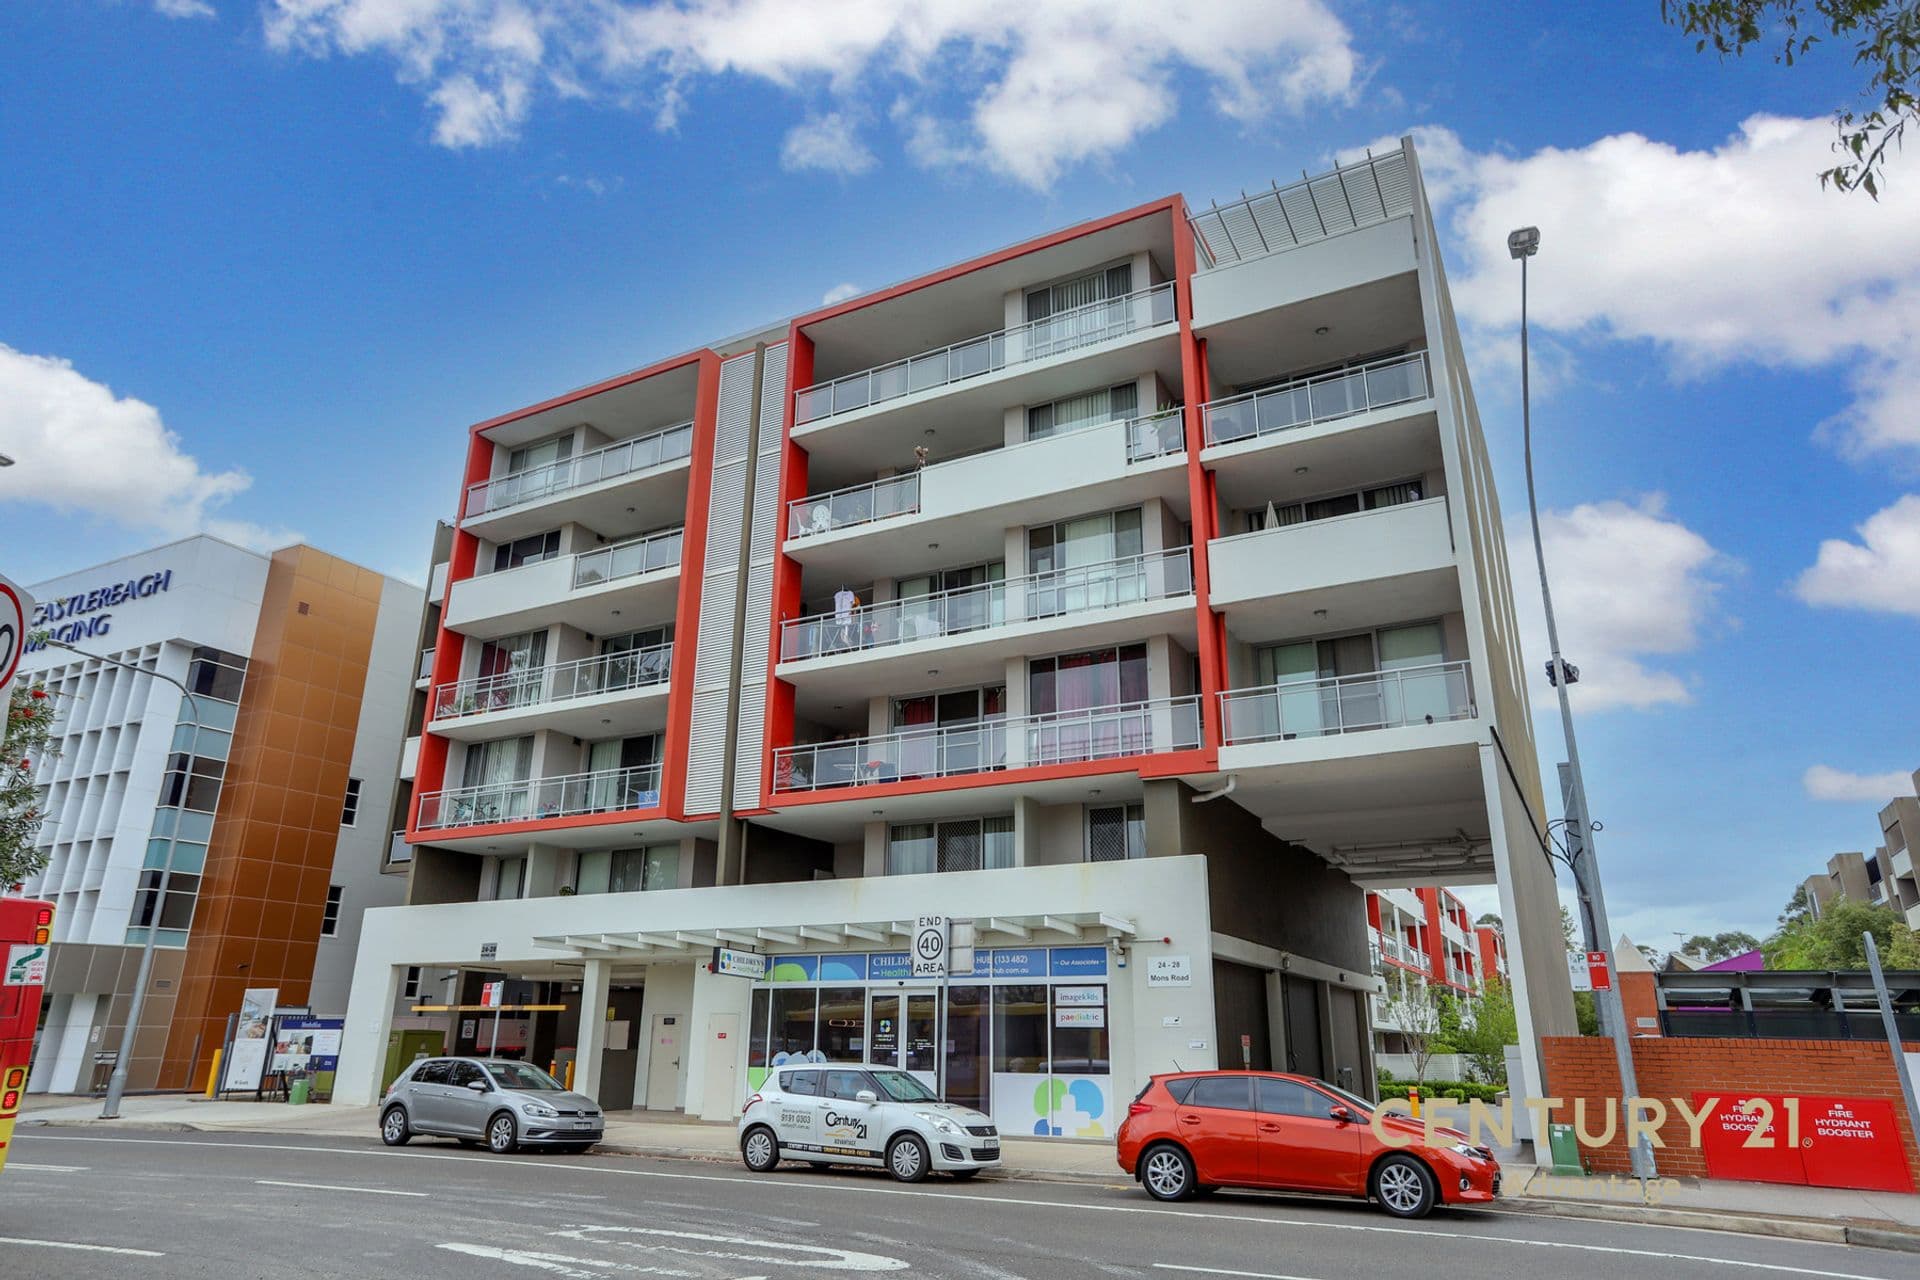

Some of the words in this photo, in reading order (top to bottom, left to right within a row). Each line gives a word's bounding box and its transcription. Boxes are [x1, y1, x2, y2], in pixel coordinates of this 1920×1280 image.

[31, 569, 172, 627] CASTLEREAGH
[919, 916, 942, 927] END
[920, 937, 940, 952] 40
[872, 956, 912, 967] CHILDR
[915, 962, 945, 973] AREA
[1828, 1109, 1854, 1118] FIRE
[825, 1111, 861, 1129] Century
[856, 1124, 867, 1139] 21
[1722, 1122, 1775, 1133] BOOSR
[1815, 1118, 1872, 1130] HYDRANT
[1817, 1127, 1875, 1139] BOOSTER
